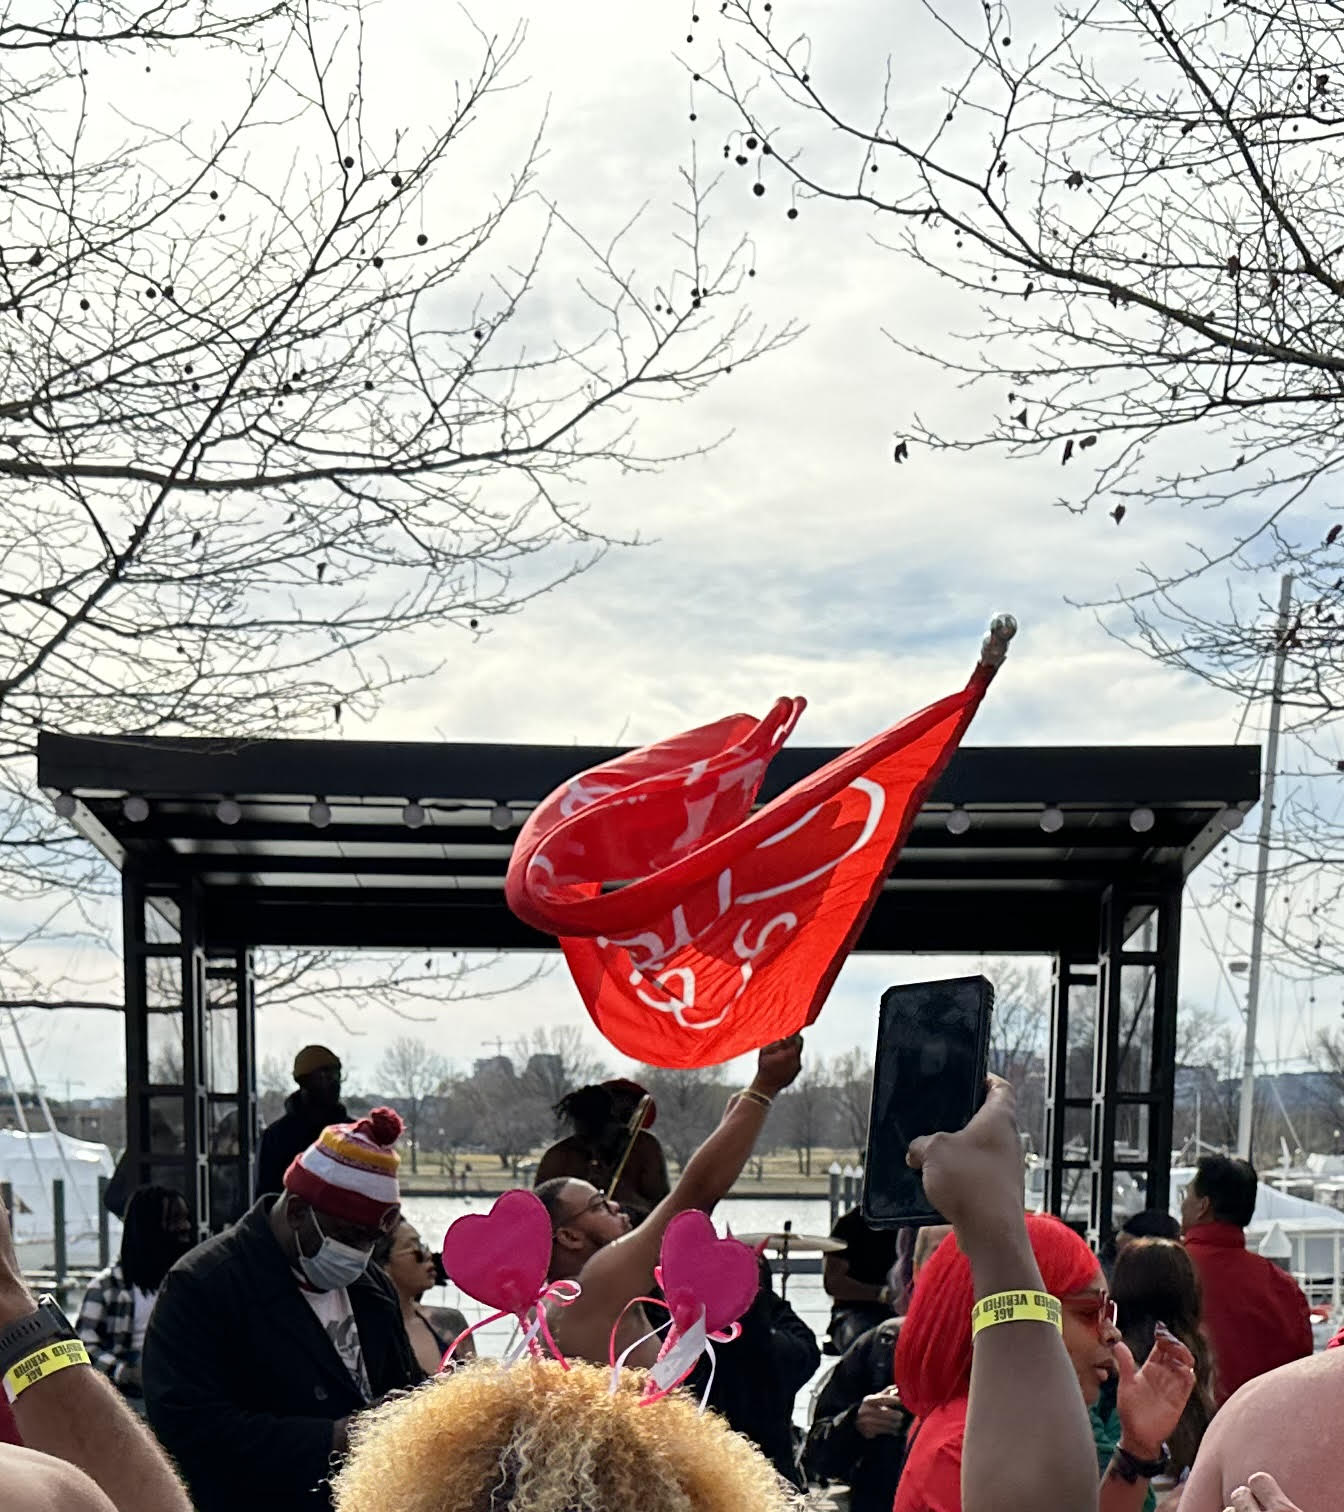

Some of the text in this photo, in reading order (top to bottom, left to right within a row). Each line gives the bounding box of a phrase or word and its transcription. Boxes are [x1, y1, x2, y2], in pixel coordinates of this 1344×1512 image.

[982, 1293, 1028, 1313] VERIFIED
[994, 1307, 1014, 1322] AGE
[13, 1352, 50, 1379] VERIFIED
[27, 1366, 43, 1383] AGE
